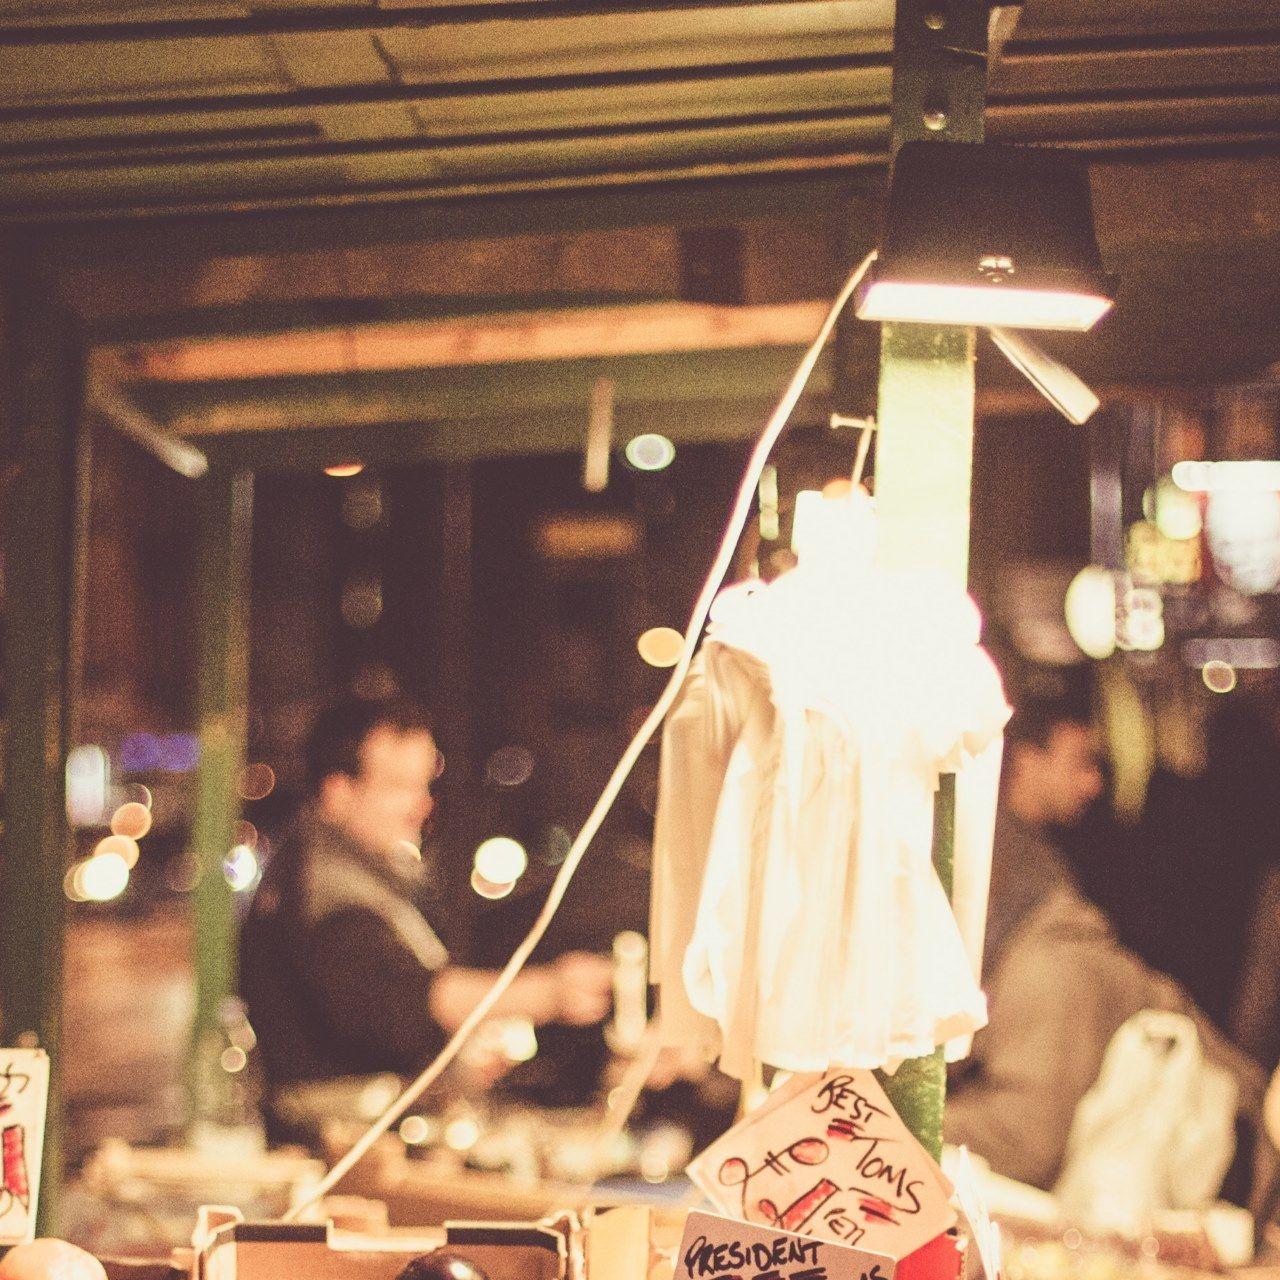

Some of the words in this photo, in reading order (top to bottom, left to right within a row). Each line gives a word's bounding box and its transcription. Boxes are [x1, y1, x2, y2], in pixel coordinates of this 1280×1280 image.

[811, 1075, 891, 1122] BEST
[851, 1134, 924, 1214] TOMS
[685, 1236, 824, 1279] PRESIDENT
